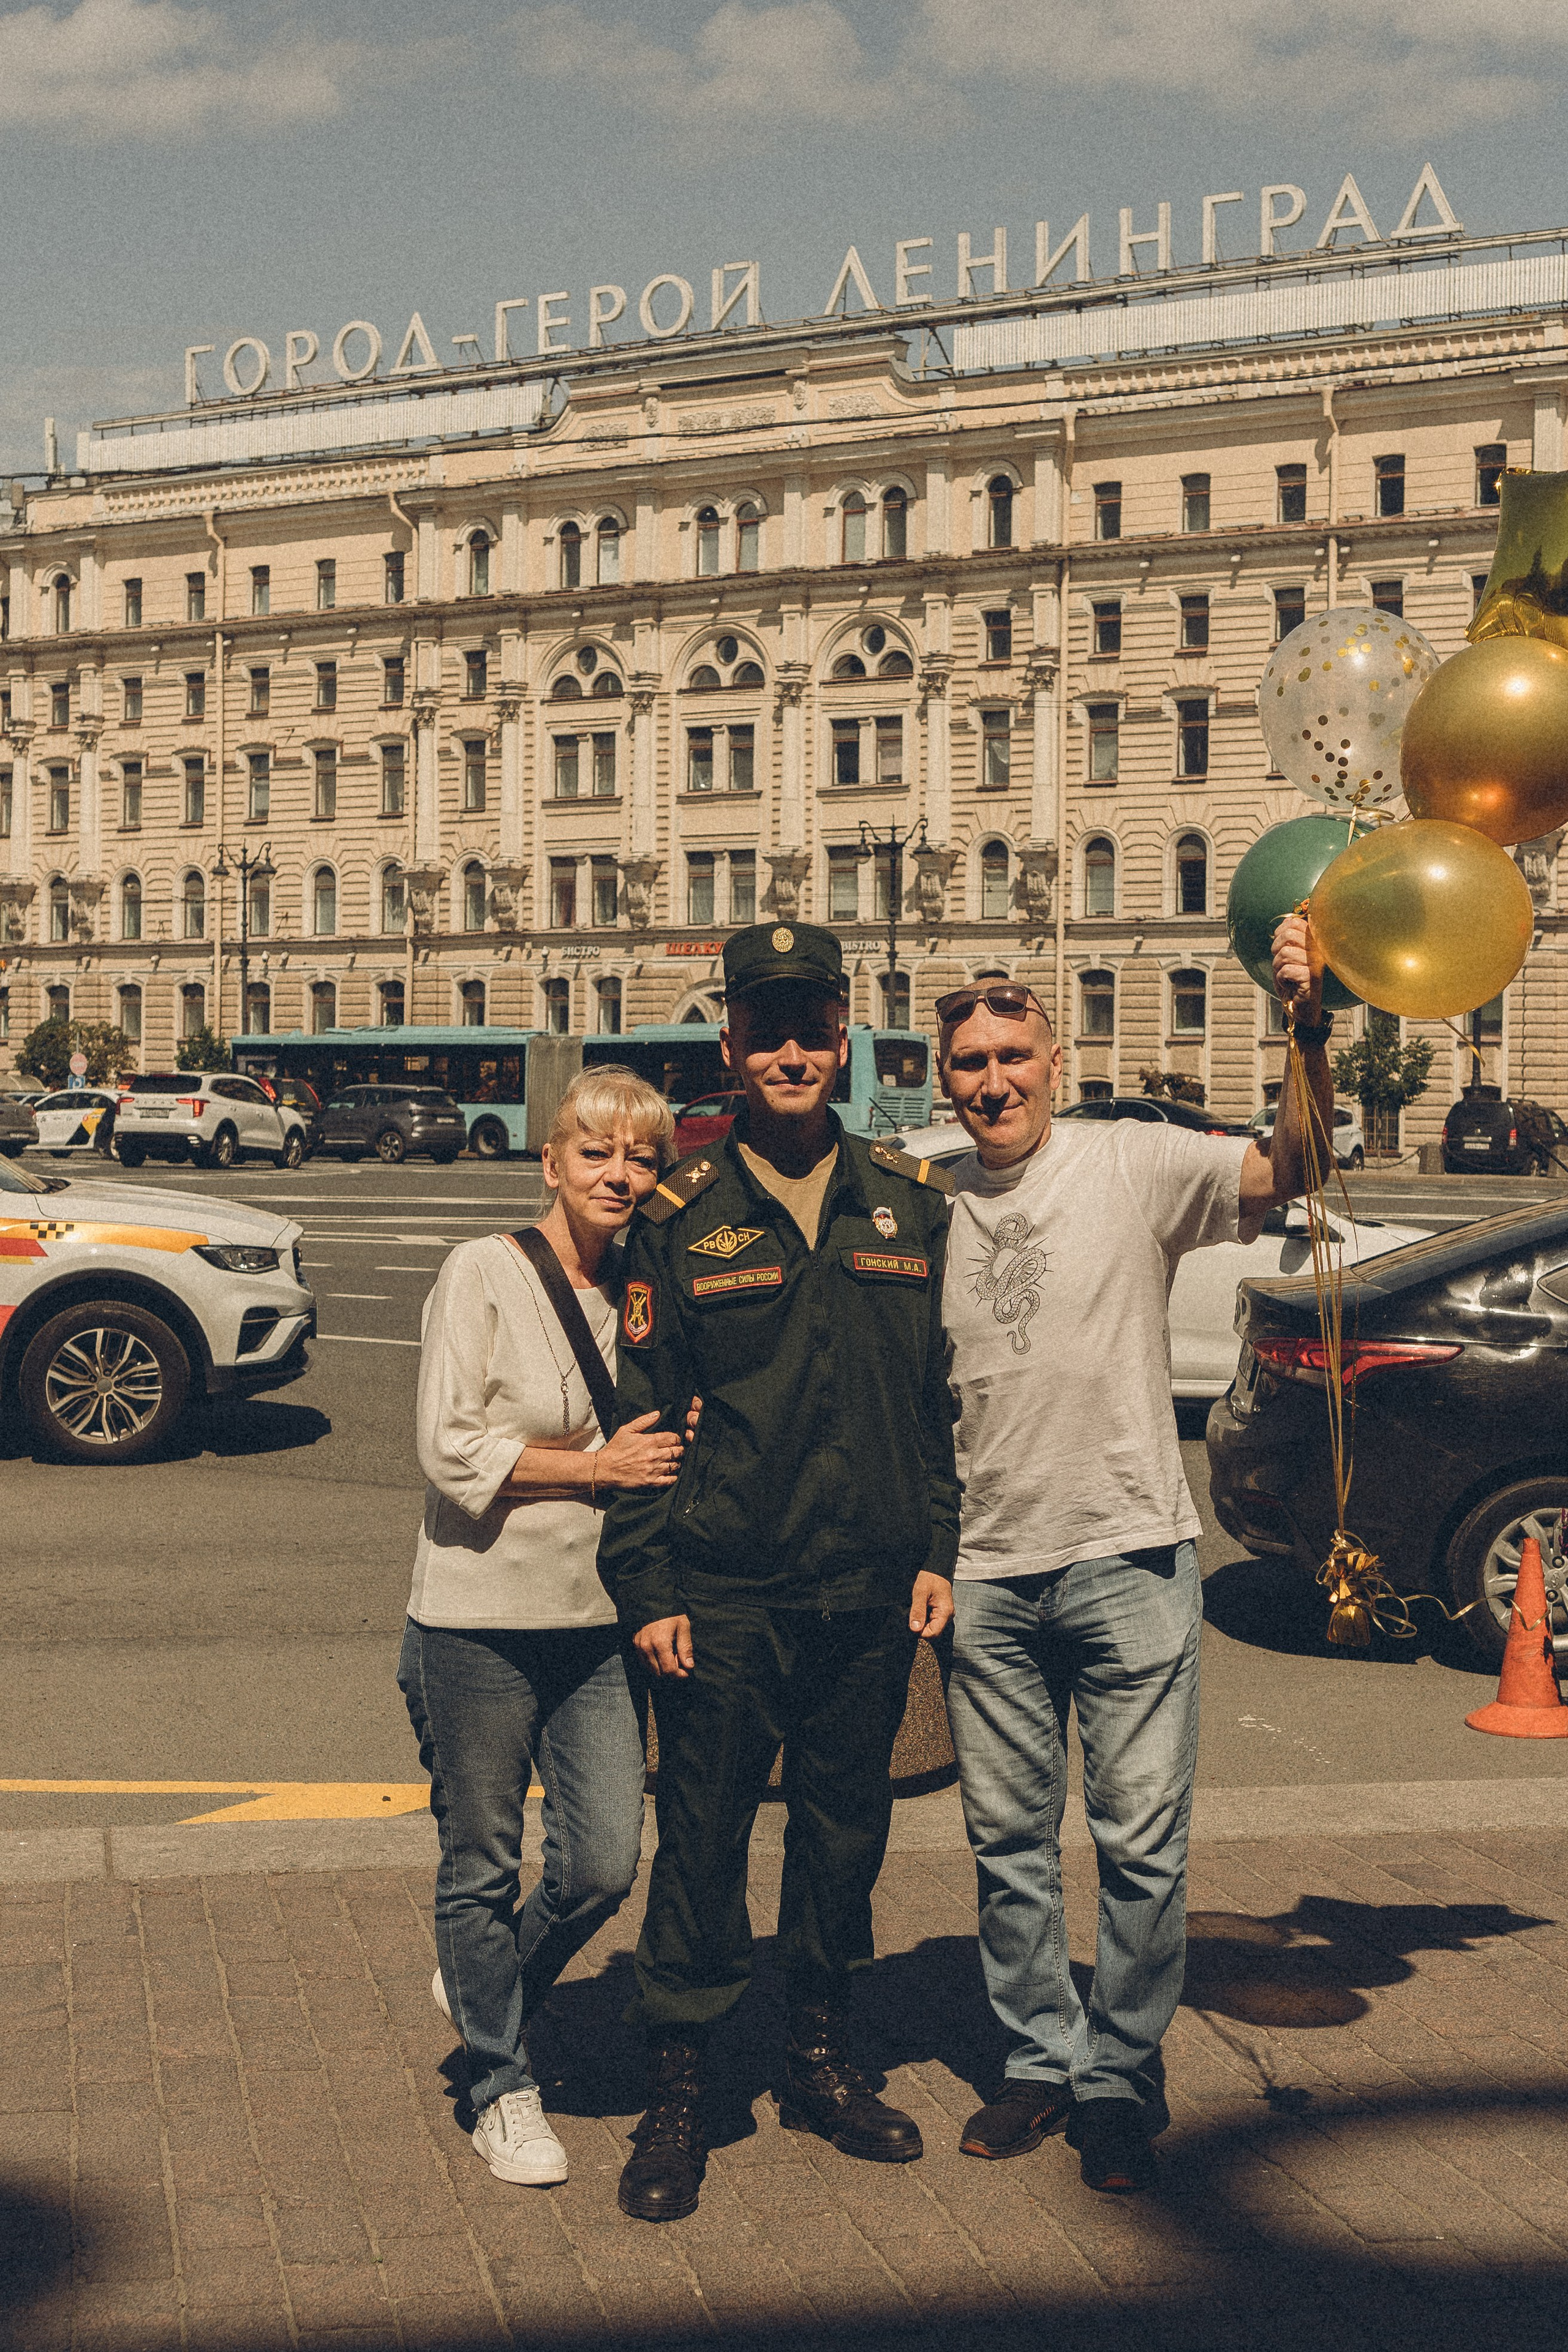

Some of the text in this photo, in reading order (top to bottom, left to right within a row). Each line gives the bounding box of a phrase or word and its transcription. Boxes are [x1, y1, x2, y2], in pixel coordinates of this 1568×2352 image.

[185, 162, 1464, 404] ГОРОД-ГЕРОЙ ЛЕНИНГРАД
[562, 946, 600, 956] БИСТРО
[666, 941, 726, 955] ЩЕЛКУ
[842, 940, 881, 951] BISTRO
[703, 1232, 750, 1250] РВ СН
[861, 1257, 922, 1273] ГОНСКИЙ М.А.
[696, 1271, 778, 1292] ВООРУЖЕННЫЕ СИЛЫ РОССИИ
